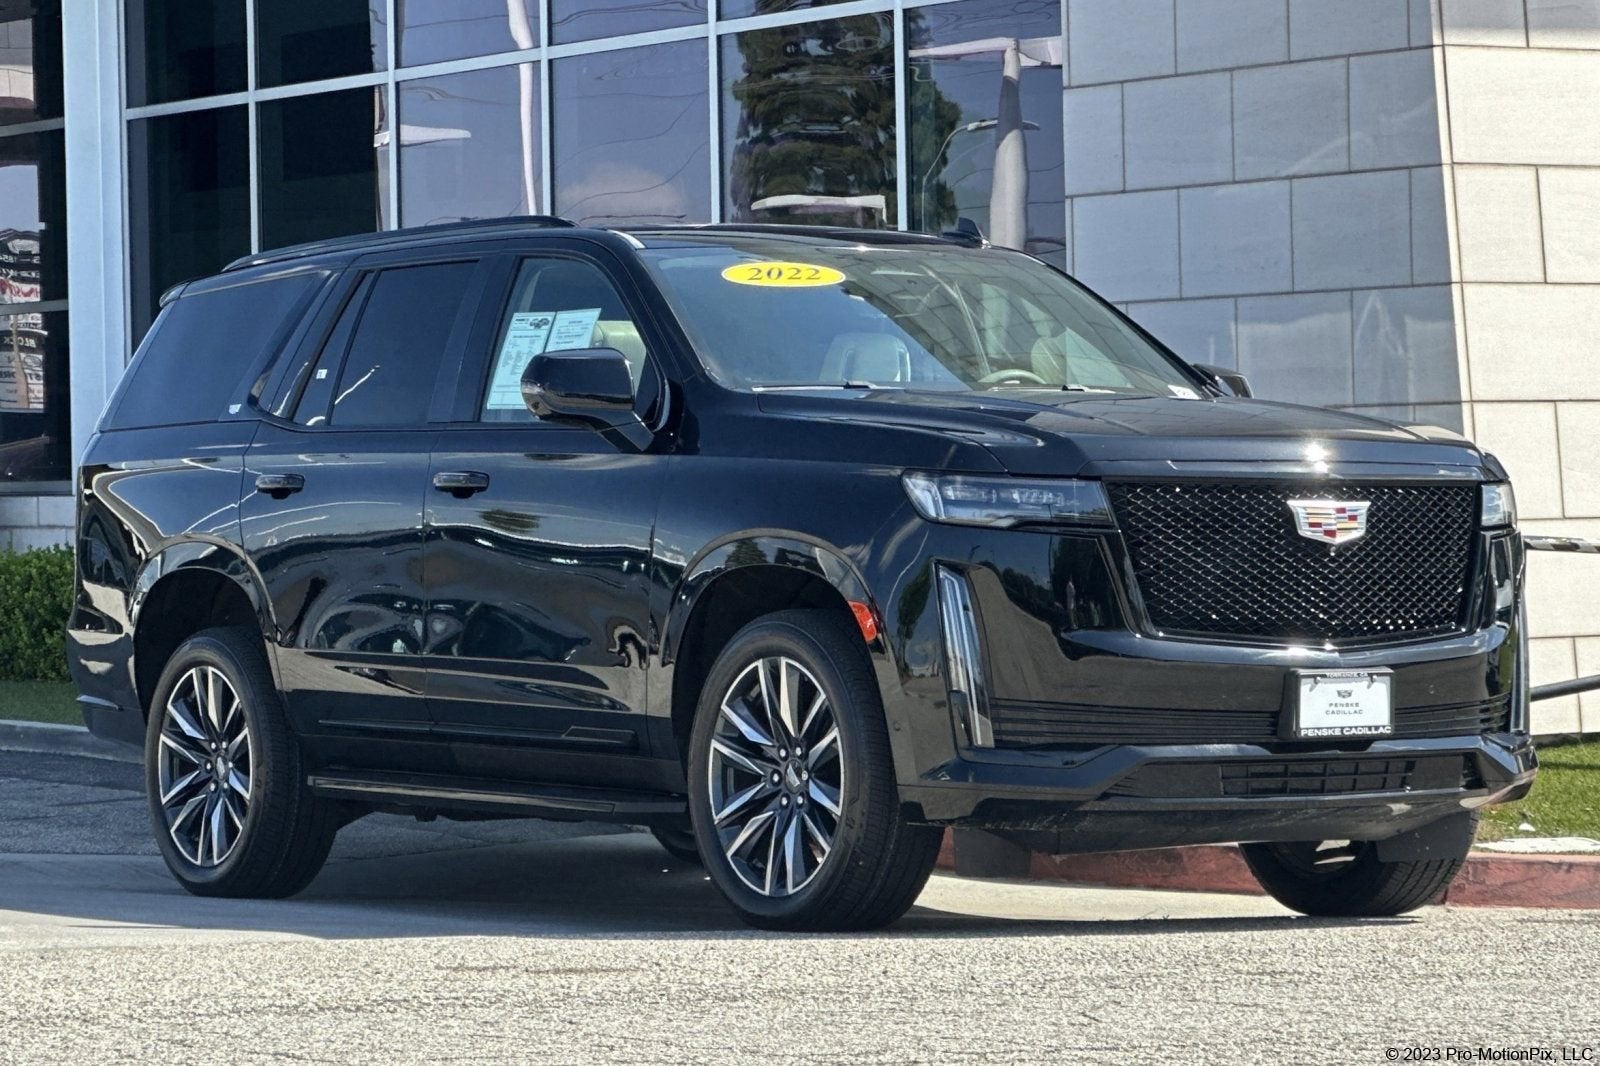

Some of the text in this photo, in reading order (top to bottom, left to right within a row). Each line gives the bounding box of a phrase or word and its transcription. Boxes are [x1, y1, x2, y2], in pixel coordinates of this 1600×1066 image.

[747, 267, 821, 280] 2022
[1301, 726, 1391, 737] PENSKE CADILLAC
